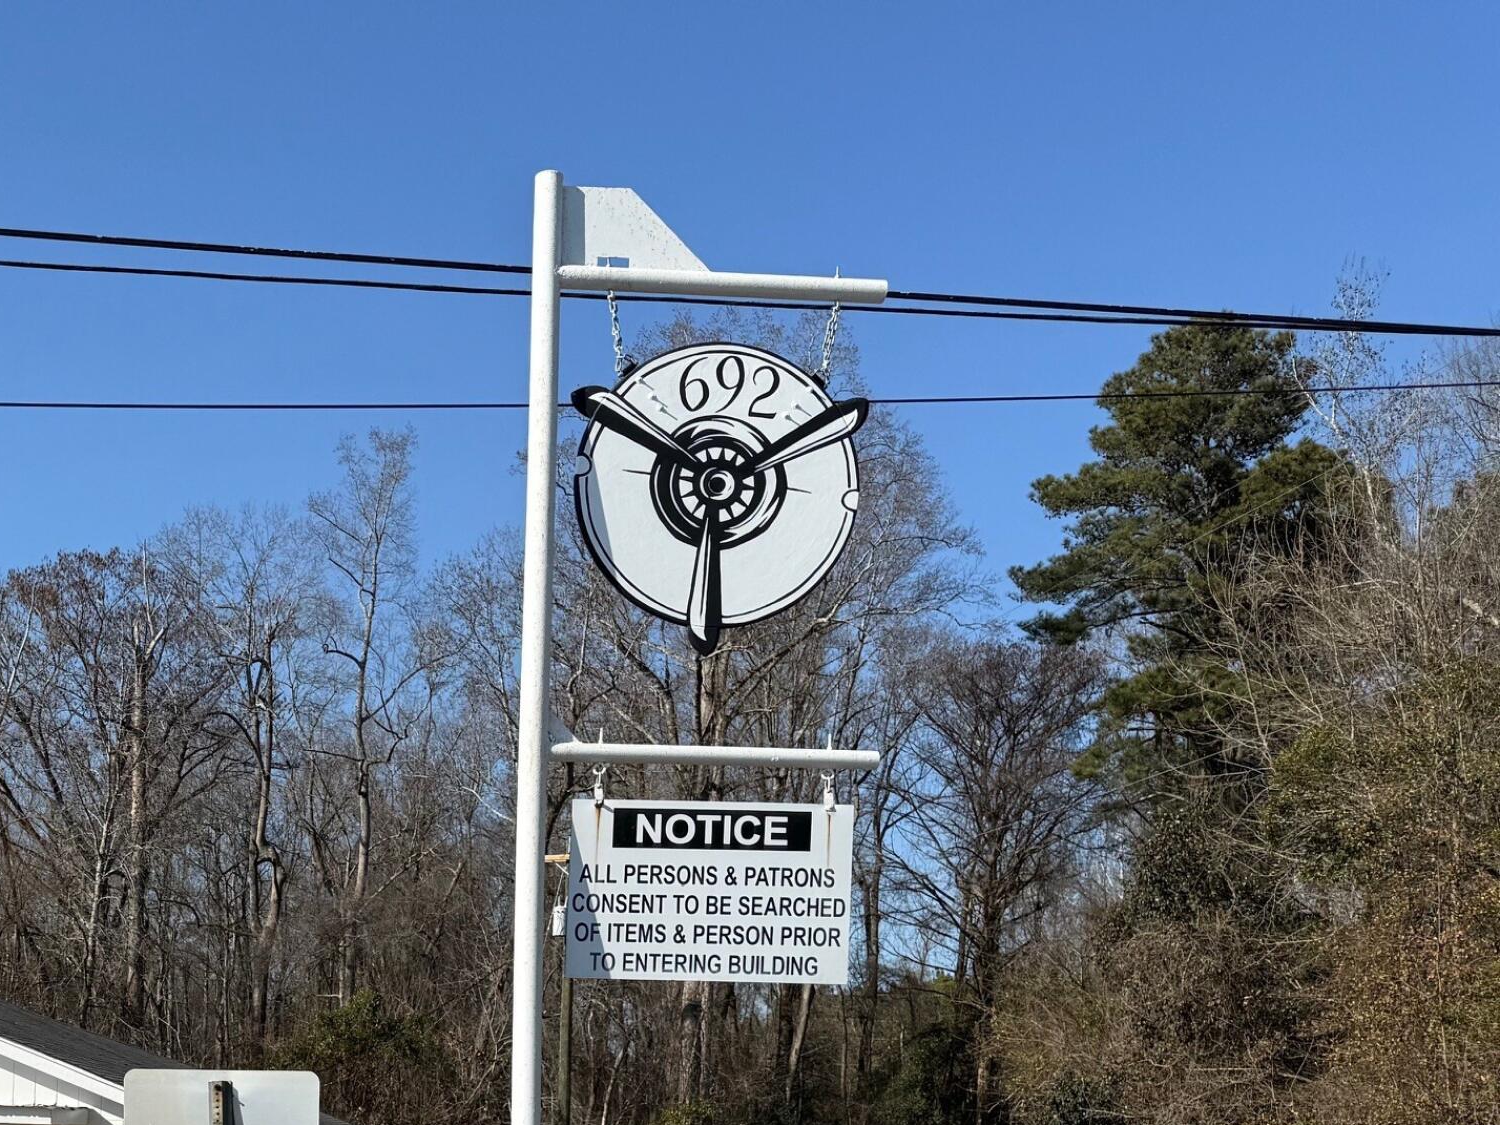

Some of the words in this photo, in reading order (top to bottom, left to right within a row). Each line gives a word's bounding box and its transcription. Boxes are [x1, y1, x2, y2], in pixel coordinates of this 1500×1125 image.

[678, 355, 781, 419] 692
[635, 813, 789, 847] NOTICE
[579, 864, 617, 884] ALL
[623, 864, 718, 887] PERSONS
[724, 866, 738, 886] &
[743, 867, 836, 888] PATRONS
[572, 893, 667, 914] CONSENT
[672, 894, 700, 915] TO
[705, 896, 732, 916] BE
[738, 896, 846, 918] SEARCHED
[574, 922, 601, 943] OF
[606, 923, 667, 944] ITEMS
[673, 924, 687, 944] &
[693, 925, 774, 946] PERSON
[780, 926, 842, 948] PRIOR
[590, 952, 617, 972] TO
[622, 953, 722, 974] ENTERING
[728, 955, 819, 976] BUILDING
